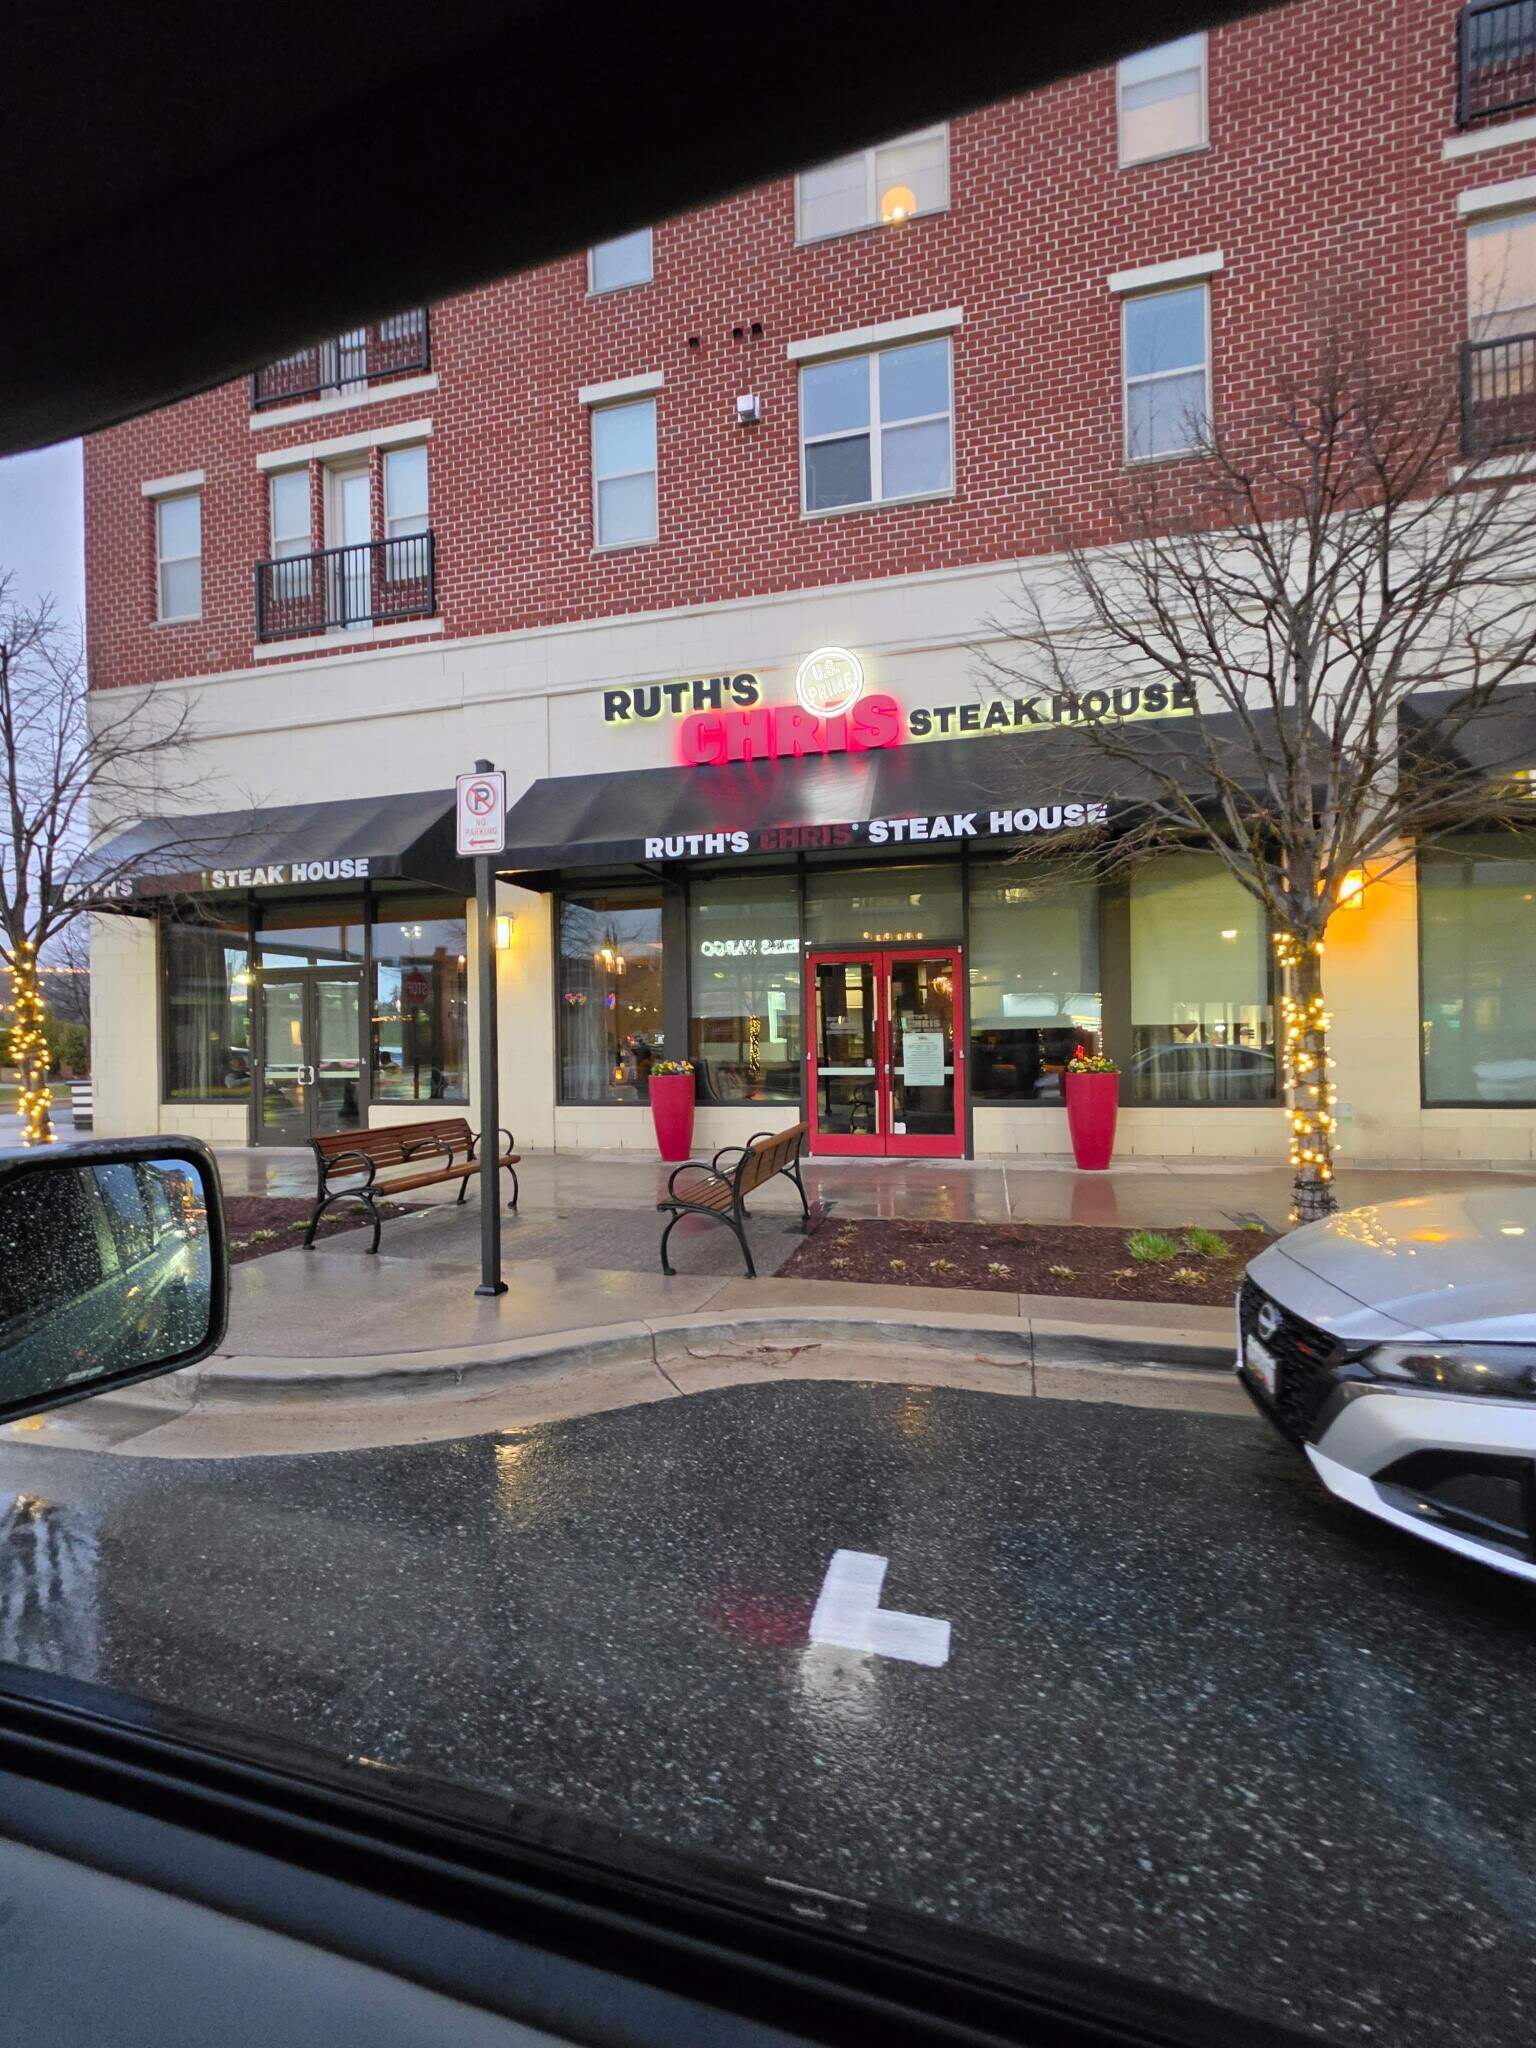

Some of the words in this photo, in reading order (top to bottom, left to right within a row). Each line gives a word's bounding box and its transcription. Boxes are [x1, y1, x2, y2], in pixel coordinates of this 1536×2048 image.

[604, 674, 759, 722] RUTH'S
[807, 672, 854, 704] PRIME
[909, 697, 1041, 736] STEAK
[1051, 681, 1197, 722] HOUSE
[680, 694, 900, 764] CHRIS
[464, 826, 497, 837] PARKING
[475, 817, 486, 827] NO
[645, 831, 750, 858] RUTH'S
[868, 814, 977, 843] STEAK
[990, 803, 1108, 834] HOUSE
[211, 865, 285, 889] STEAK
[291, 858, 370, 882] HOUSE
